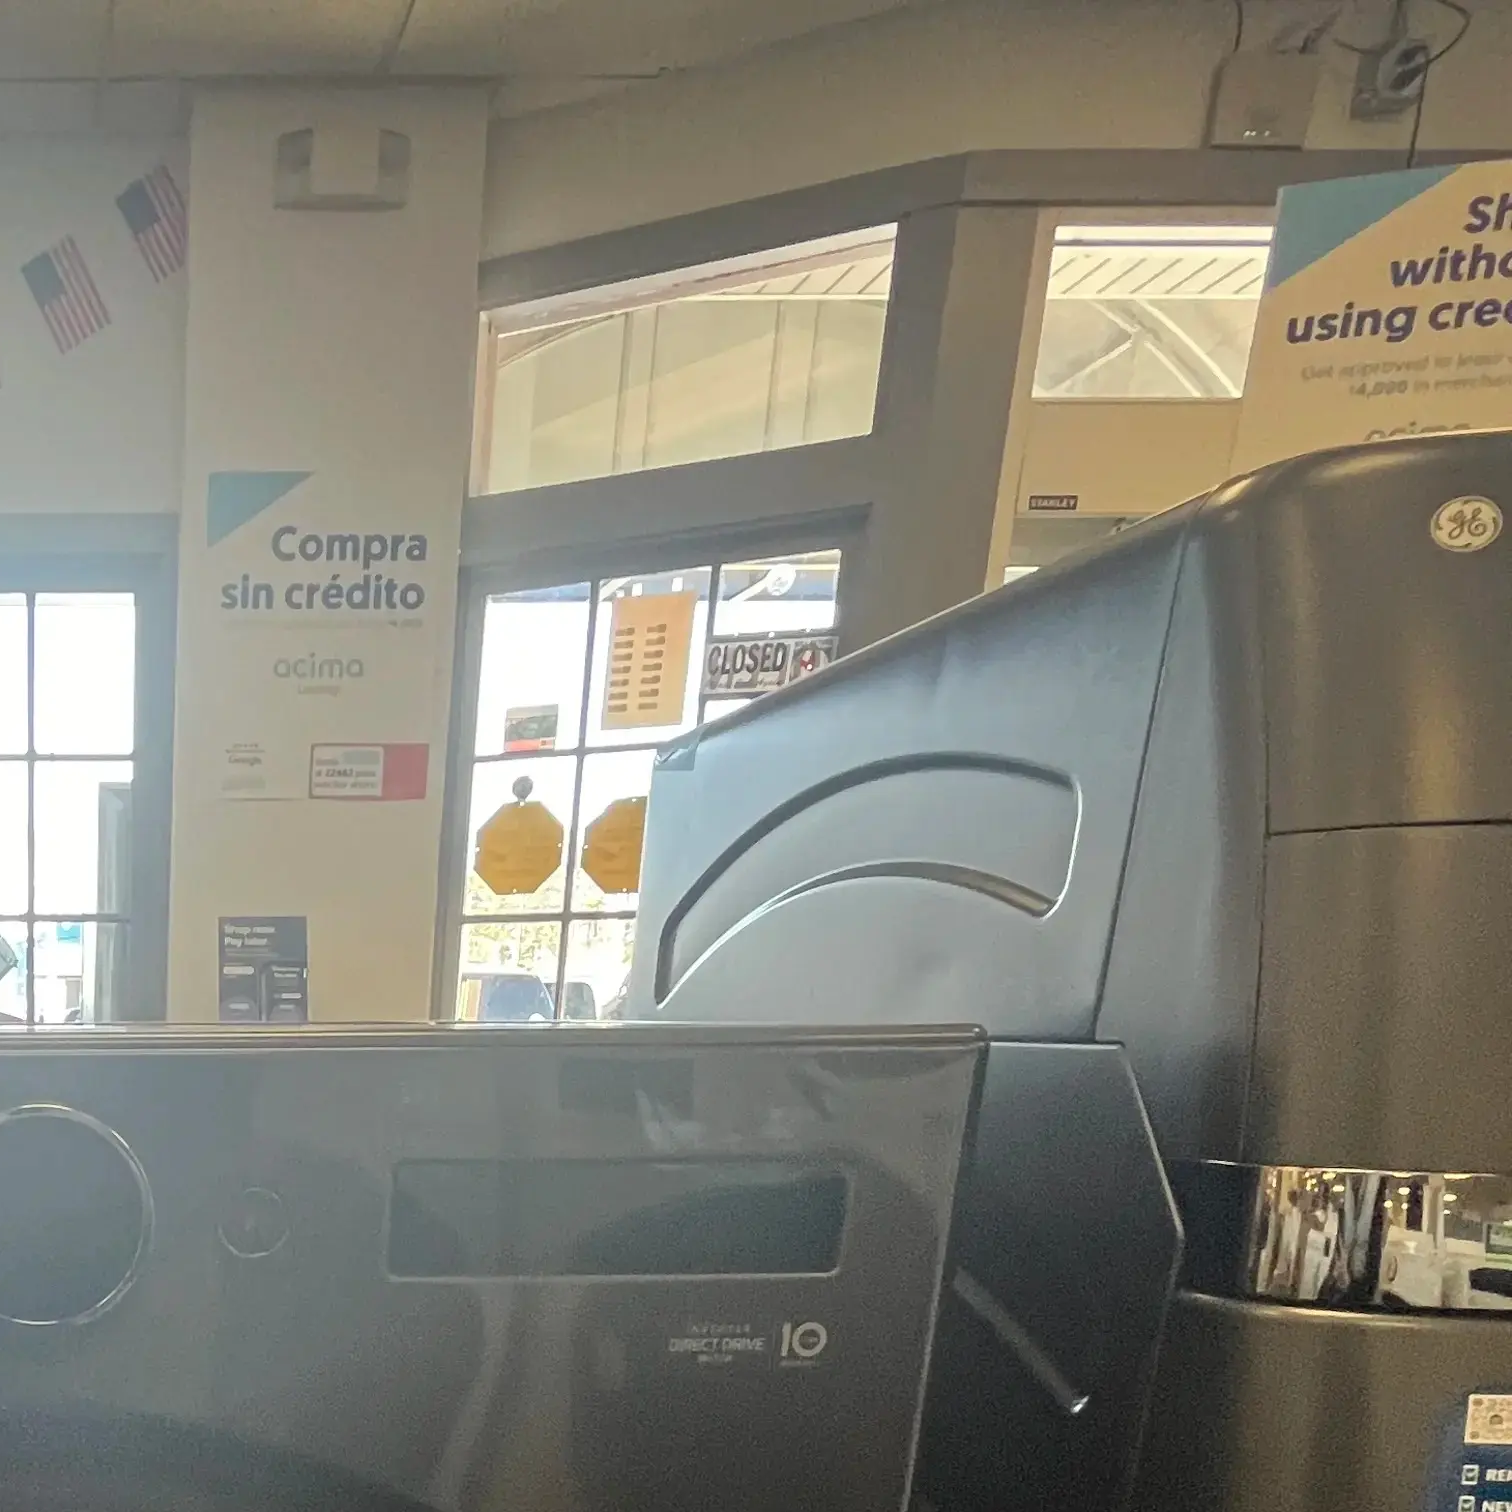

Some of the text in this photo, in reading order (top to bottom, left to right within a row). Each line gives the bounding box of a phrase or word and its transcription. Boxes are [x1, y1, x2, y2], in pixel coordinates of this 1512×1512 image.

[1286, 301, 1418, 344] using
[271, 525, 428, 569] Compra
[220, 573, 426, 611] sin crédito
[273, 652, 365, 678] acima
[707, 642, 787, 677] CLOSED
